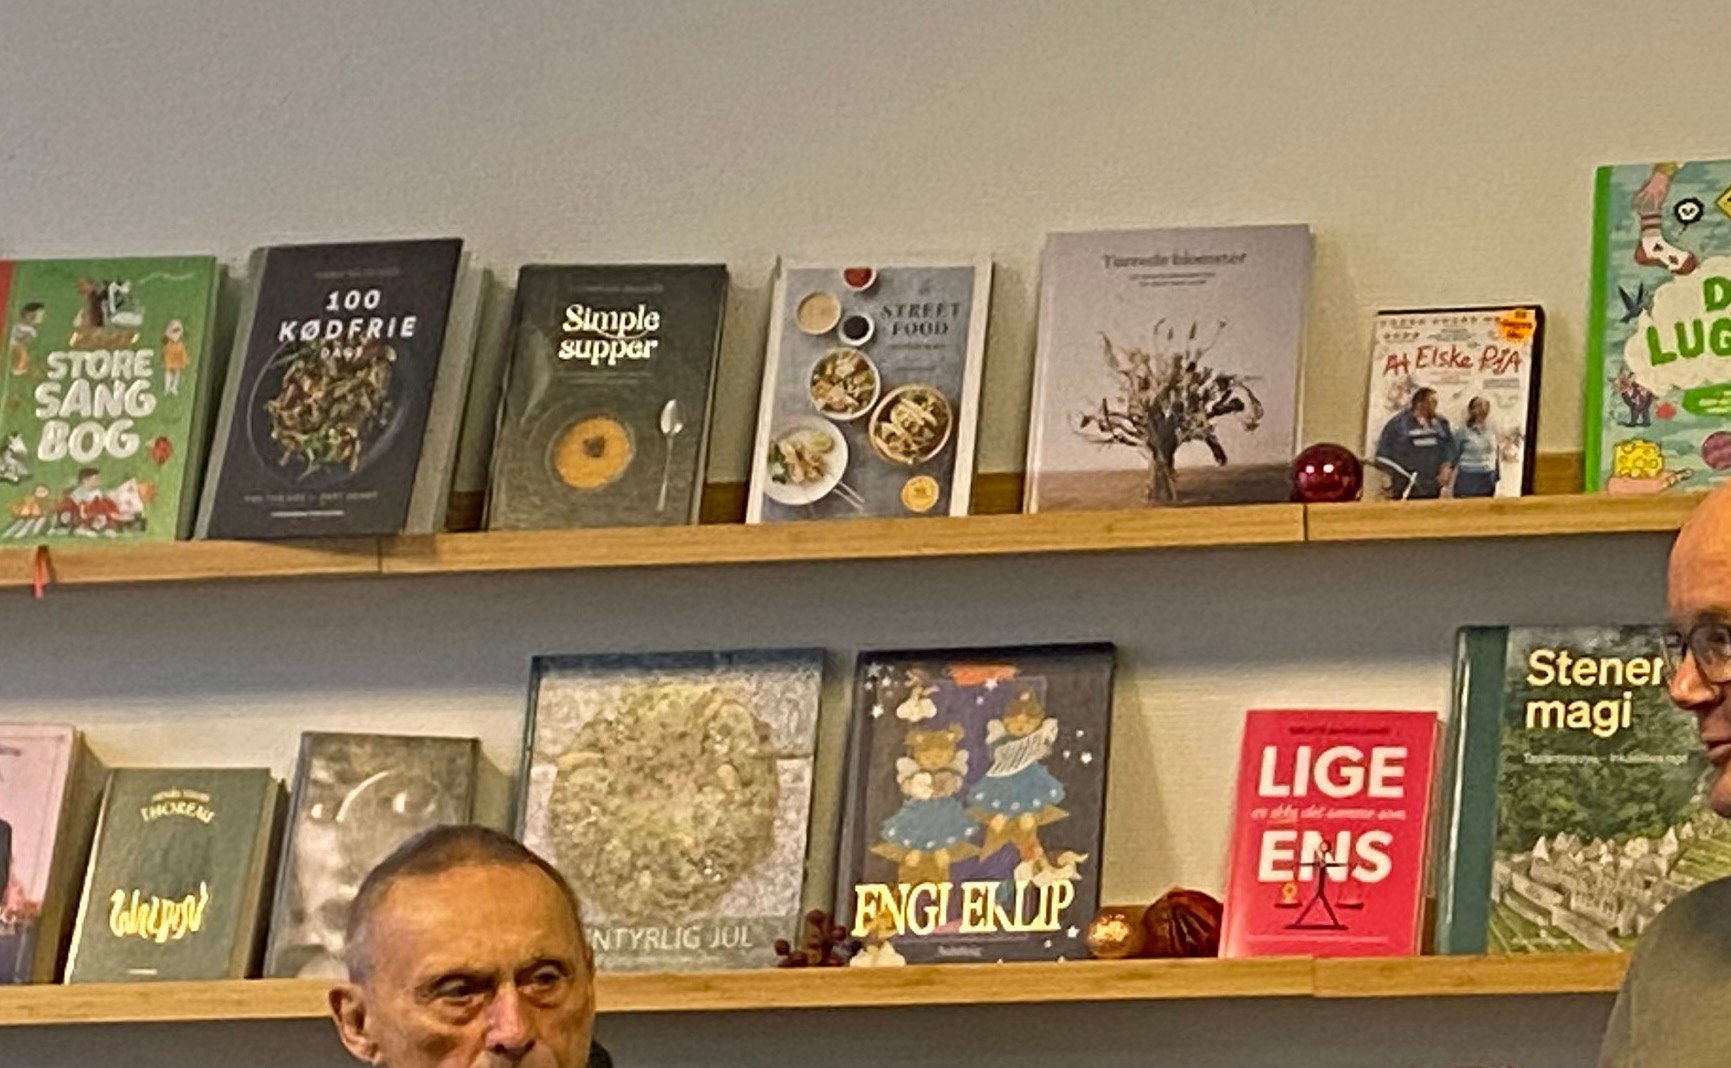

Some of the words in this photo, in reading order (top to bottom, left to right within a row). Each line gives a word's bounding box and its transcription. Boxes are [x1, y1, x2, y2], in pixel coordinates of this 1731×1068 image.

[325, 289, 382, 312] 100
[881, 302, 960, 320] STREET
[278, 315, 418, 342] KØDFRIE
[562, 303, 660, 339] Simple
[892, 321, 949, 336] FOOD
[47, 349, 155, 380] STORE
[558, 339, 659, 366] supper
[34, 378, 157, 420] SANG
[37, 418, 141, 463] BOG
[1526, 691, 1633, 739] magi
[1258, 745, 1408, 798] LIGE
[1258, 829, 1394, 884] ENS
[585, 926, 700, 951] NTYRLIG
[709, 925, 752, 949] JUL
